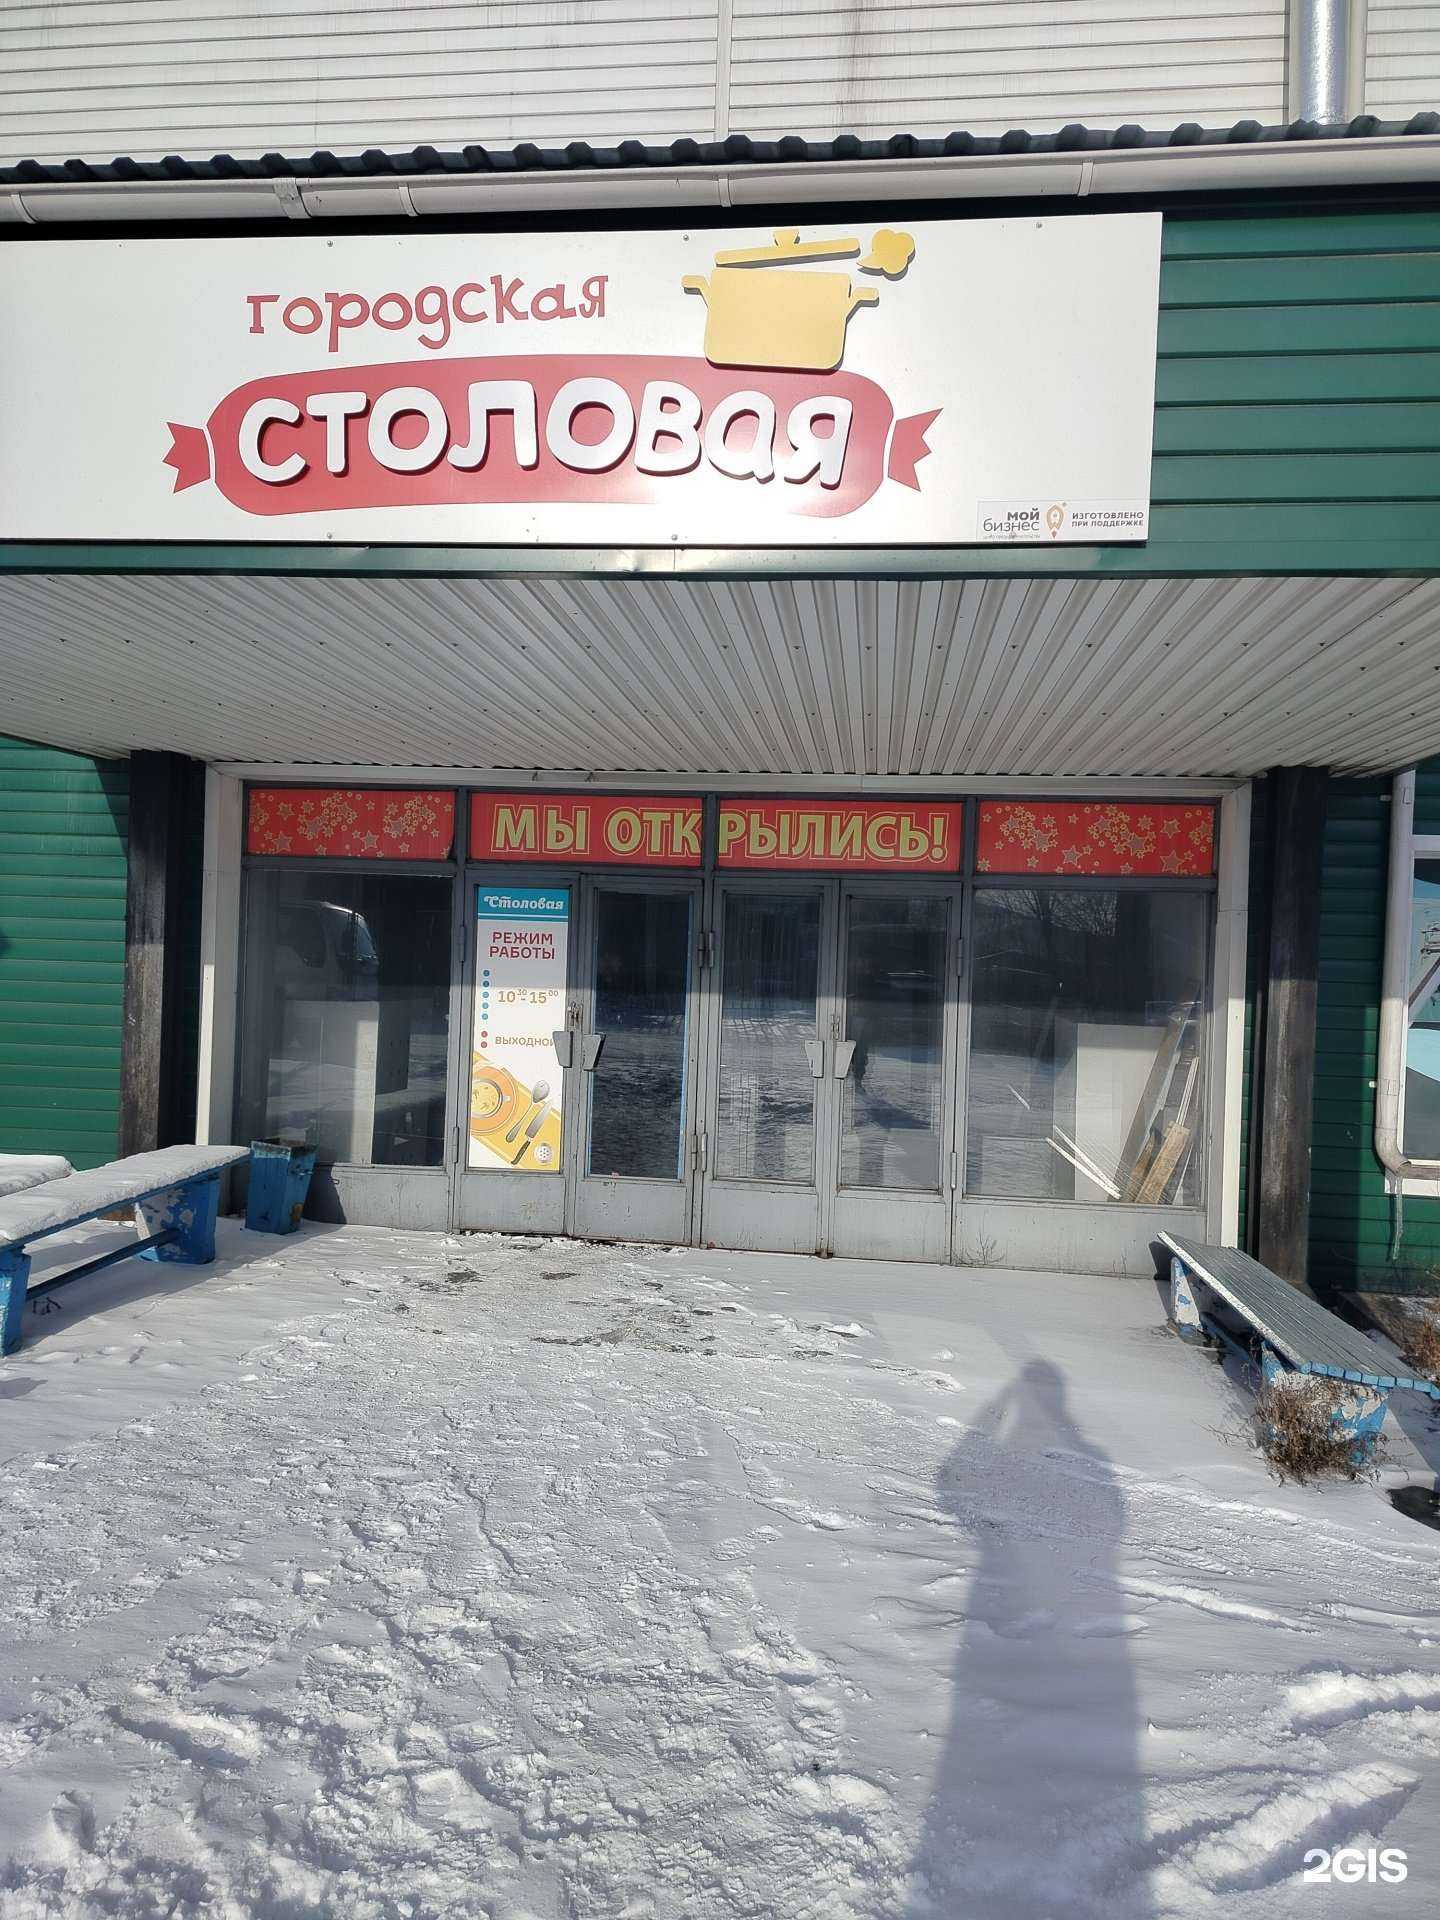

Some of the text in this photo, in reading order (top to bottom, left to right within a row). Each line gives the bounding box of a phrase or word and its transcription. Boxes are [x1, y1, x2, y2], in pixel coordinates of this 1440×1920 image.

[246, 274, 609, 352] городская
[1072, 520, 1089, 528] ПРИ
[492, 804, 589, 854] МЫ
[483, 895, 564, 910] Столовая
[492, 931, 553, 945] РЕЖИМ
[489, 946, 555, 960] РАБОТЫ
